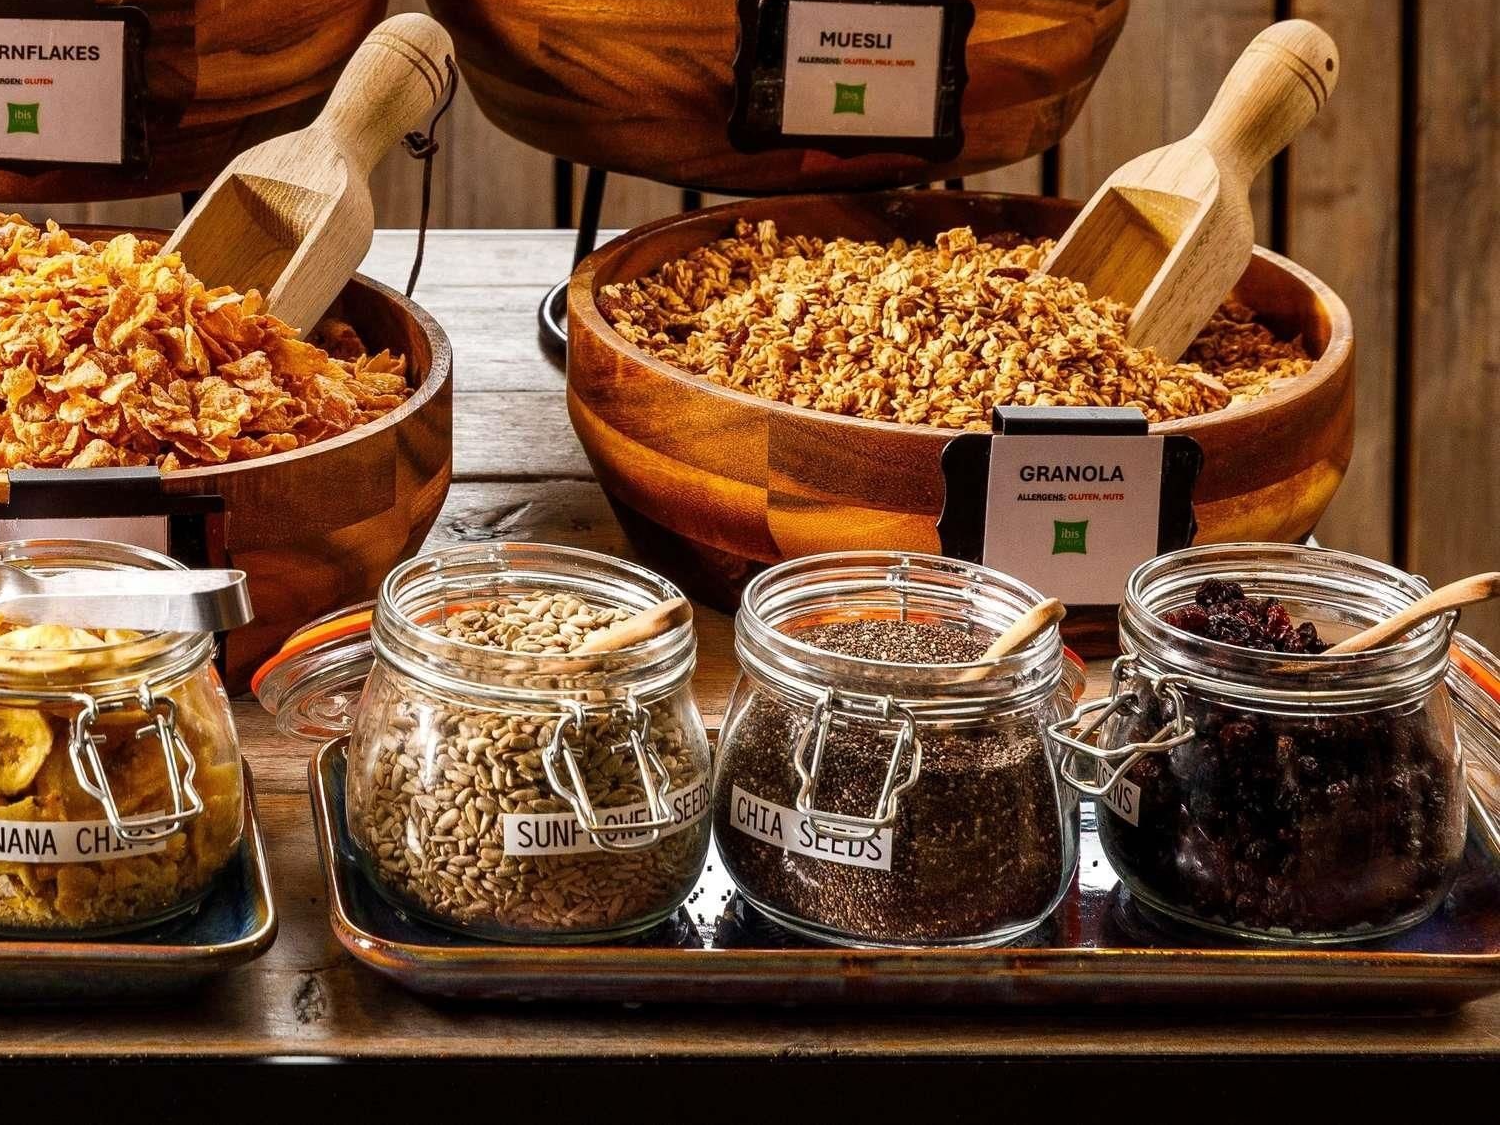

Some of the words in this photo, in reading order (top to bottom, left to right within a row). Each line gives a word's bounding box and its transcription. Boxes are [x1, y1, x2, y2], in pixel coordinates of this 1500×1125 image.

[820, 31, 892, 49] MUESLI
[14, 108, 32, 120] ibis
[1020, 465, 1124, 482] GRANOLA
[1017, 493, 1066, 501] ALLERGENS:
[1068, 493, 1101, 501] GLUTEN,
[1061, 527, 1080, 538] ibis
[673, 778, 710, 825] SEEDS
[737, 796, 783, 841] CHIA
